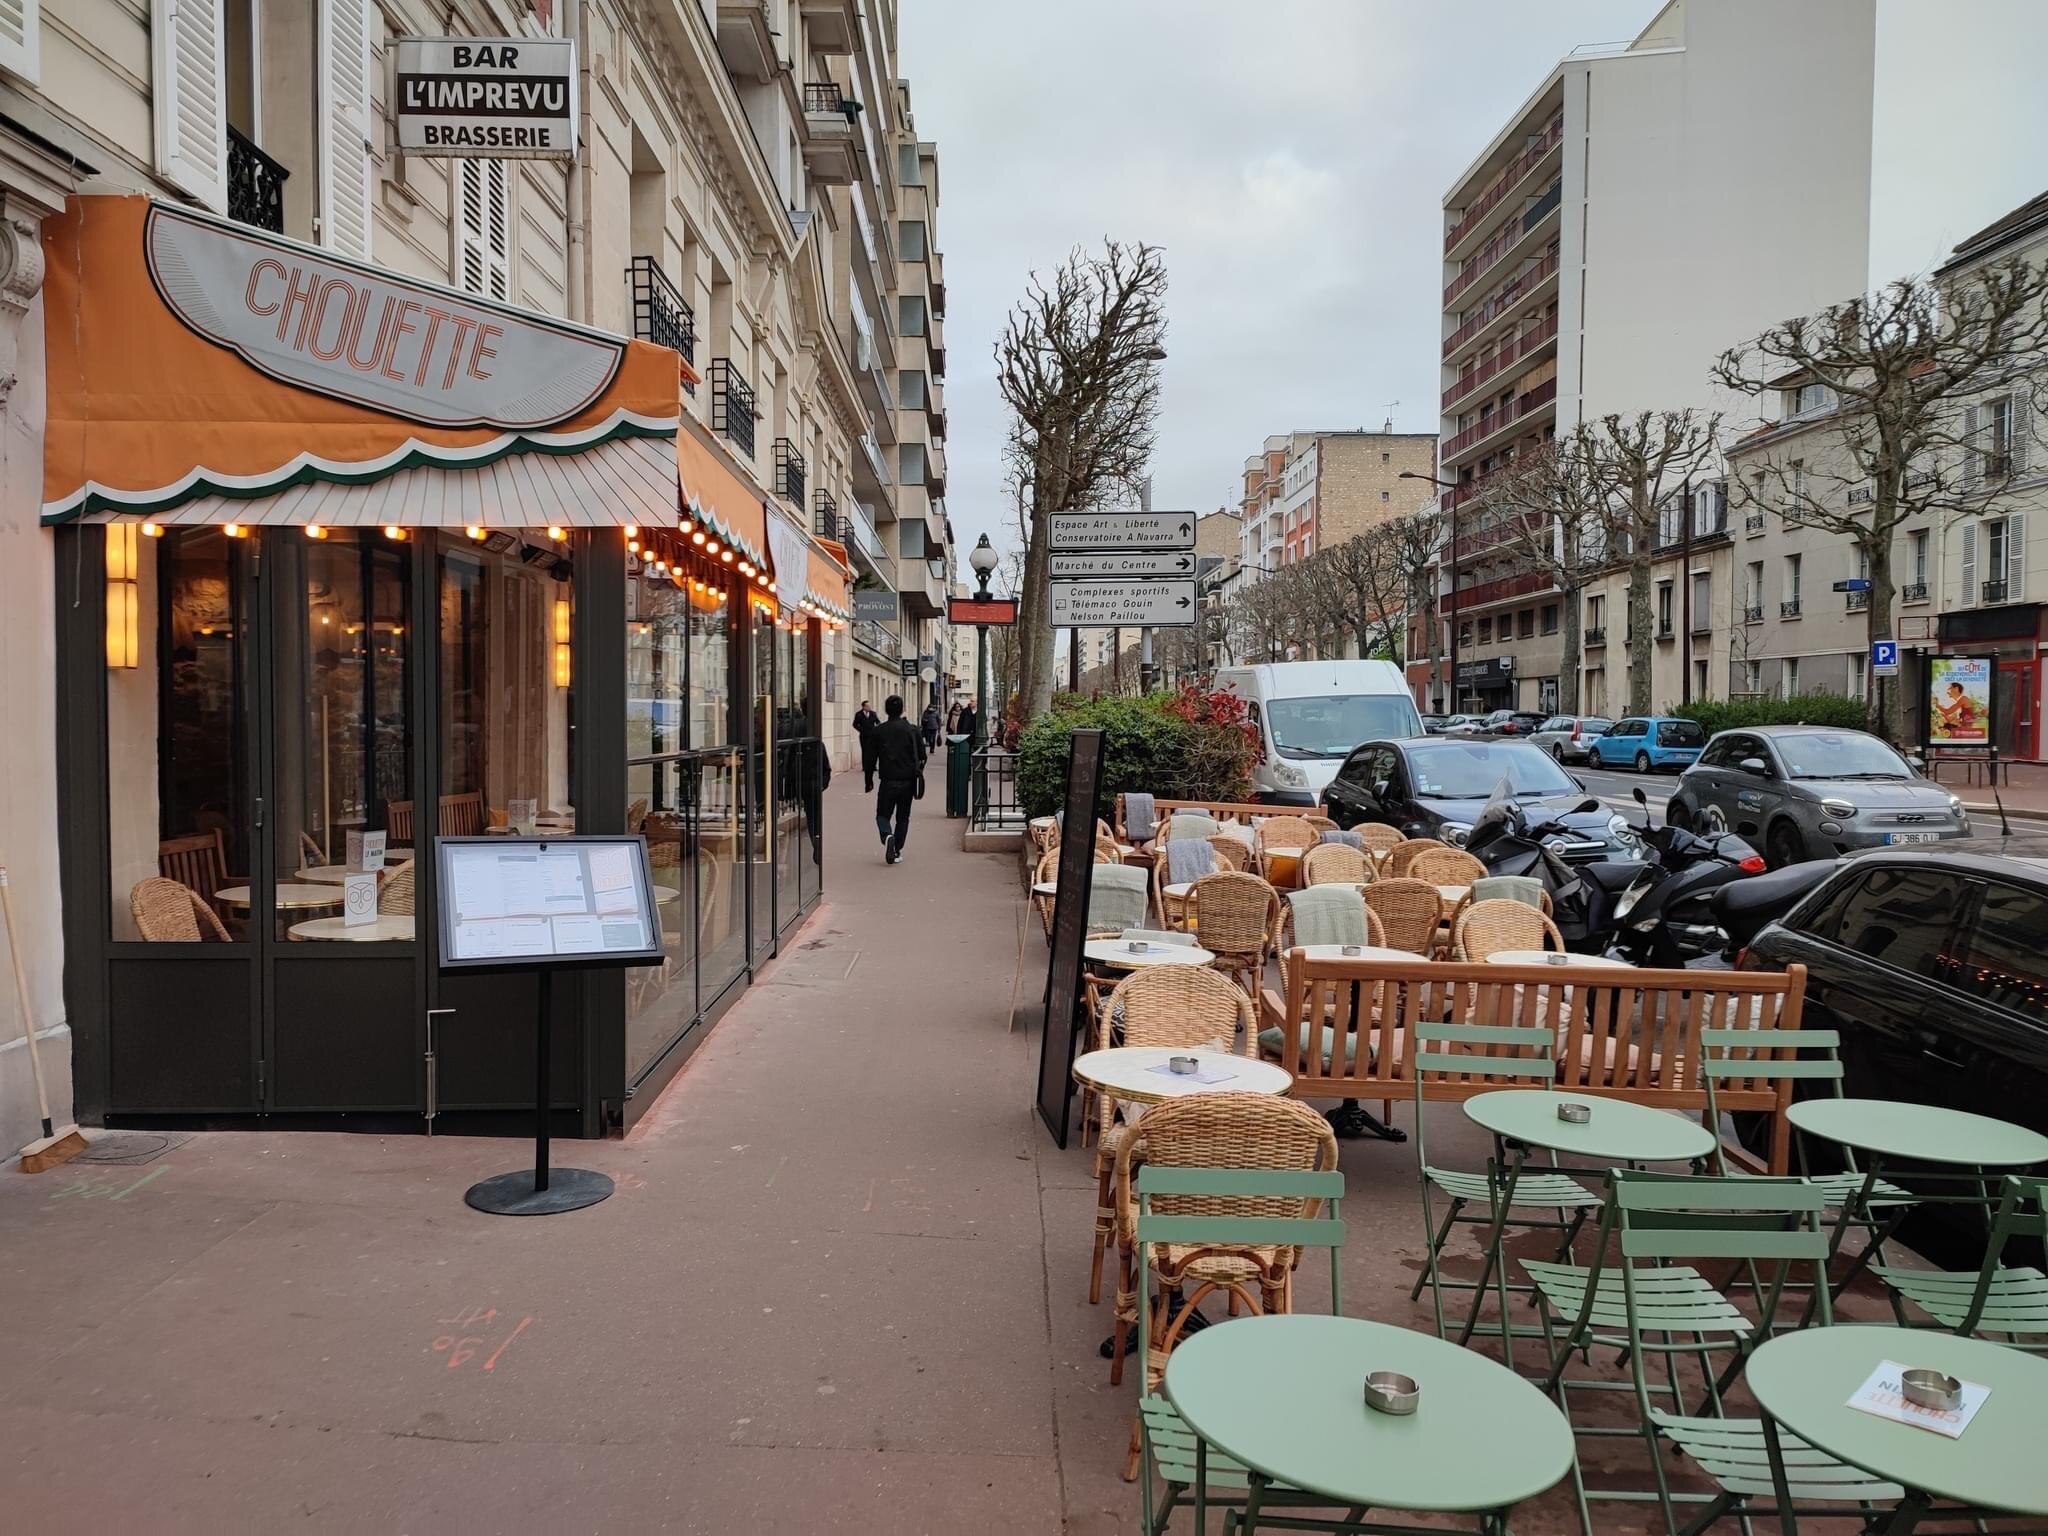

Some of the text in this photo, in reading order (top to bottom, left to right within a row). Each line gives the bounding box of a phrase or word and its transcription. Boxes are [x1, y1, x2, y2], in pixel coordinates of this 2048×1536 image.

[453, 46, 518, 69] BAR
[406, 81, 563, 111] L'IMPREVU
[424, 125, 550, 147] BRASSERIE
[244, 257, 505, 391] CHOUETTE
[1055, 520, 1088, 530] Espace
[1093, 521, 1108, 529] Art
[1125, 520, 1159, 528] Liberté
[1055, 533, 1122, 543] Conservatoire
[1055, 560, 1157, 570] Marché du Centre
[1070, 587, 1170, 598] Complexes sportifs
[1072, 599, 1153, 609] Télémaco Gouin
[1070, 612, 1145, 620] Nelson Paillou
[1878, 646, 1890, 662] P
